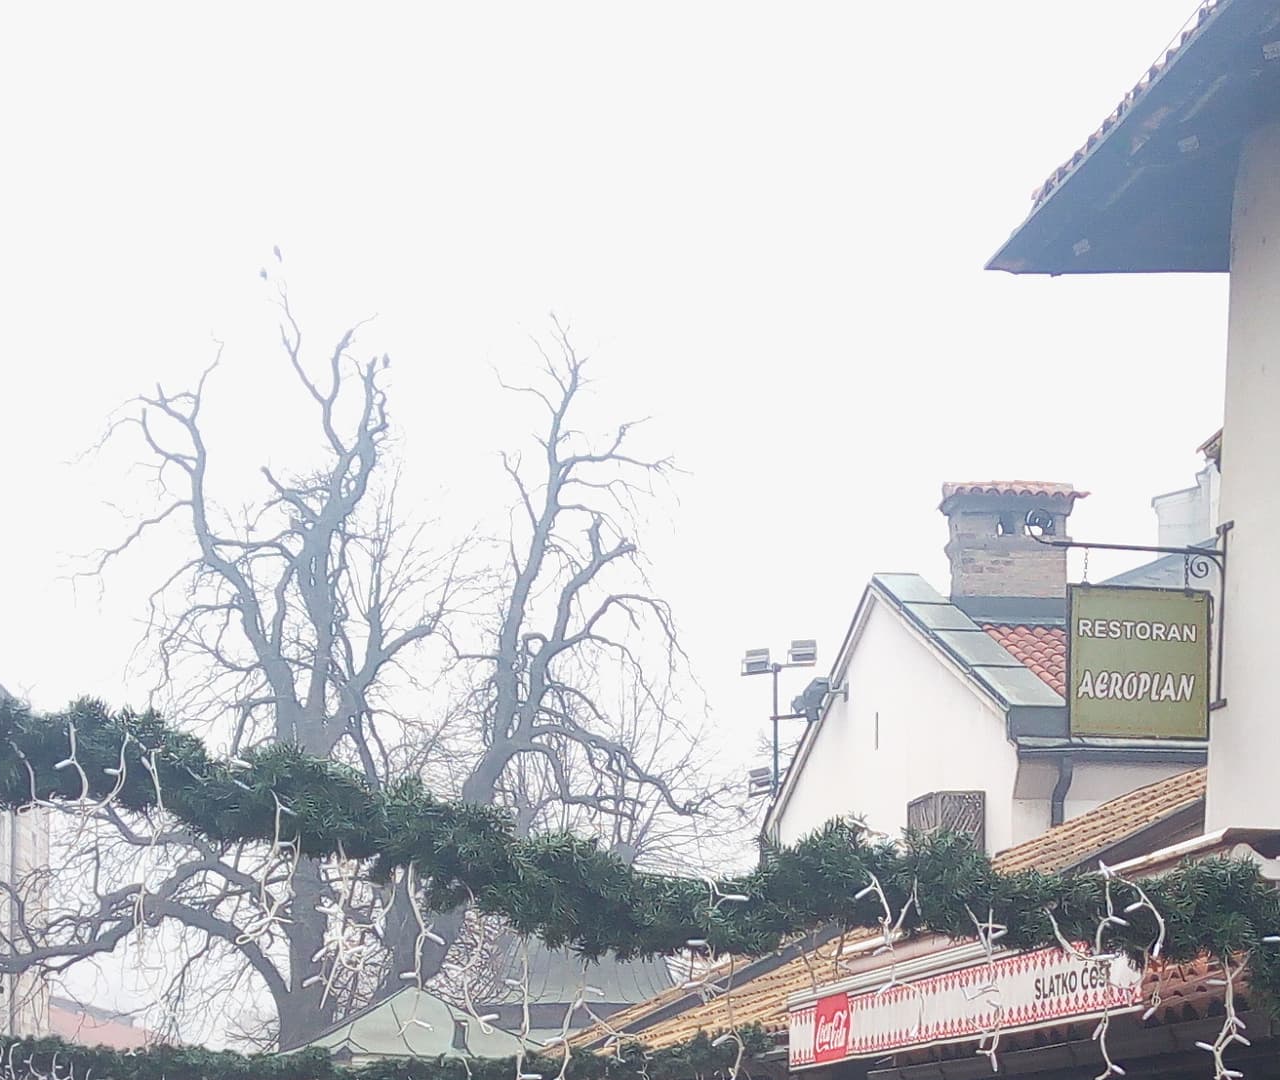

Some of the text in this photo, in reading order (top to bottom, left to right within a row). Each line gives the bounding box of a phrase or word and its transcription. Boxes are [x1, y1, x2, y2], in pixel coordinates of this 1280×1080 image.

[1079, 619, 1197, 642] RESTORAN
[1077, 670, 1196, 701] AEROPLAN
[1035, 970, 1078, 1000] SLATKO
